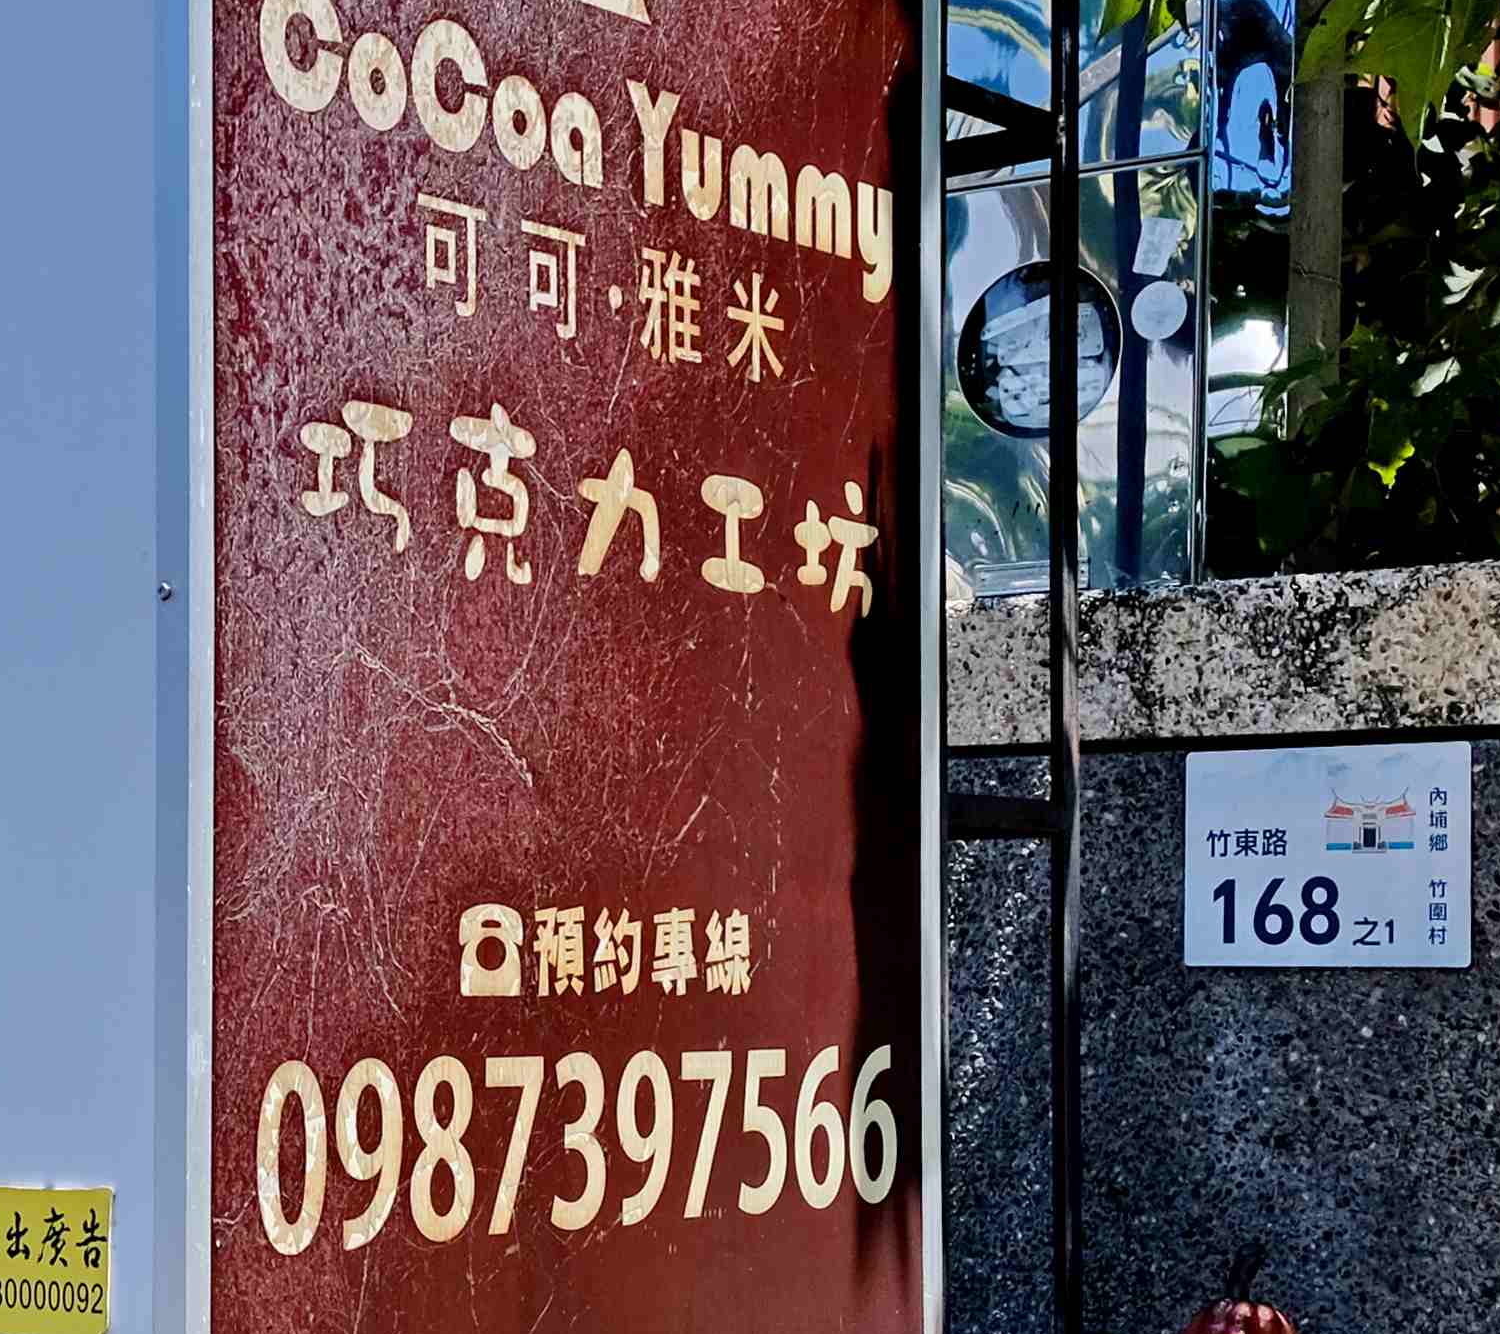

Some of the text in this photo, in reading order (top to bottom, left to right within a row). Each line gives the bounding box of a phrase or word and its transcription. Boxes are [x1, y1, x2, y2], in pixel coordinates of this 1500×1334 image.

[627, 78, 893, 303] Yummy
[300, 401, 879, 616] 巧克力工坊
[1206, 828, 1288, 857] 竹東路
[532, 905, 753, 998] 預約專線
[256, 1044, 898, 1256] 0987397566
